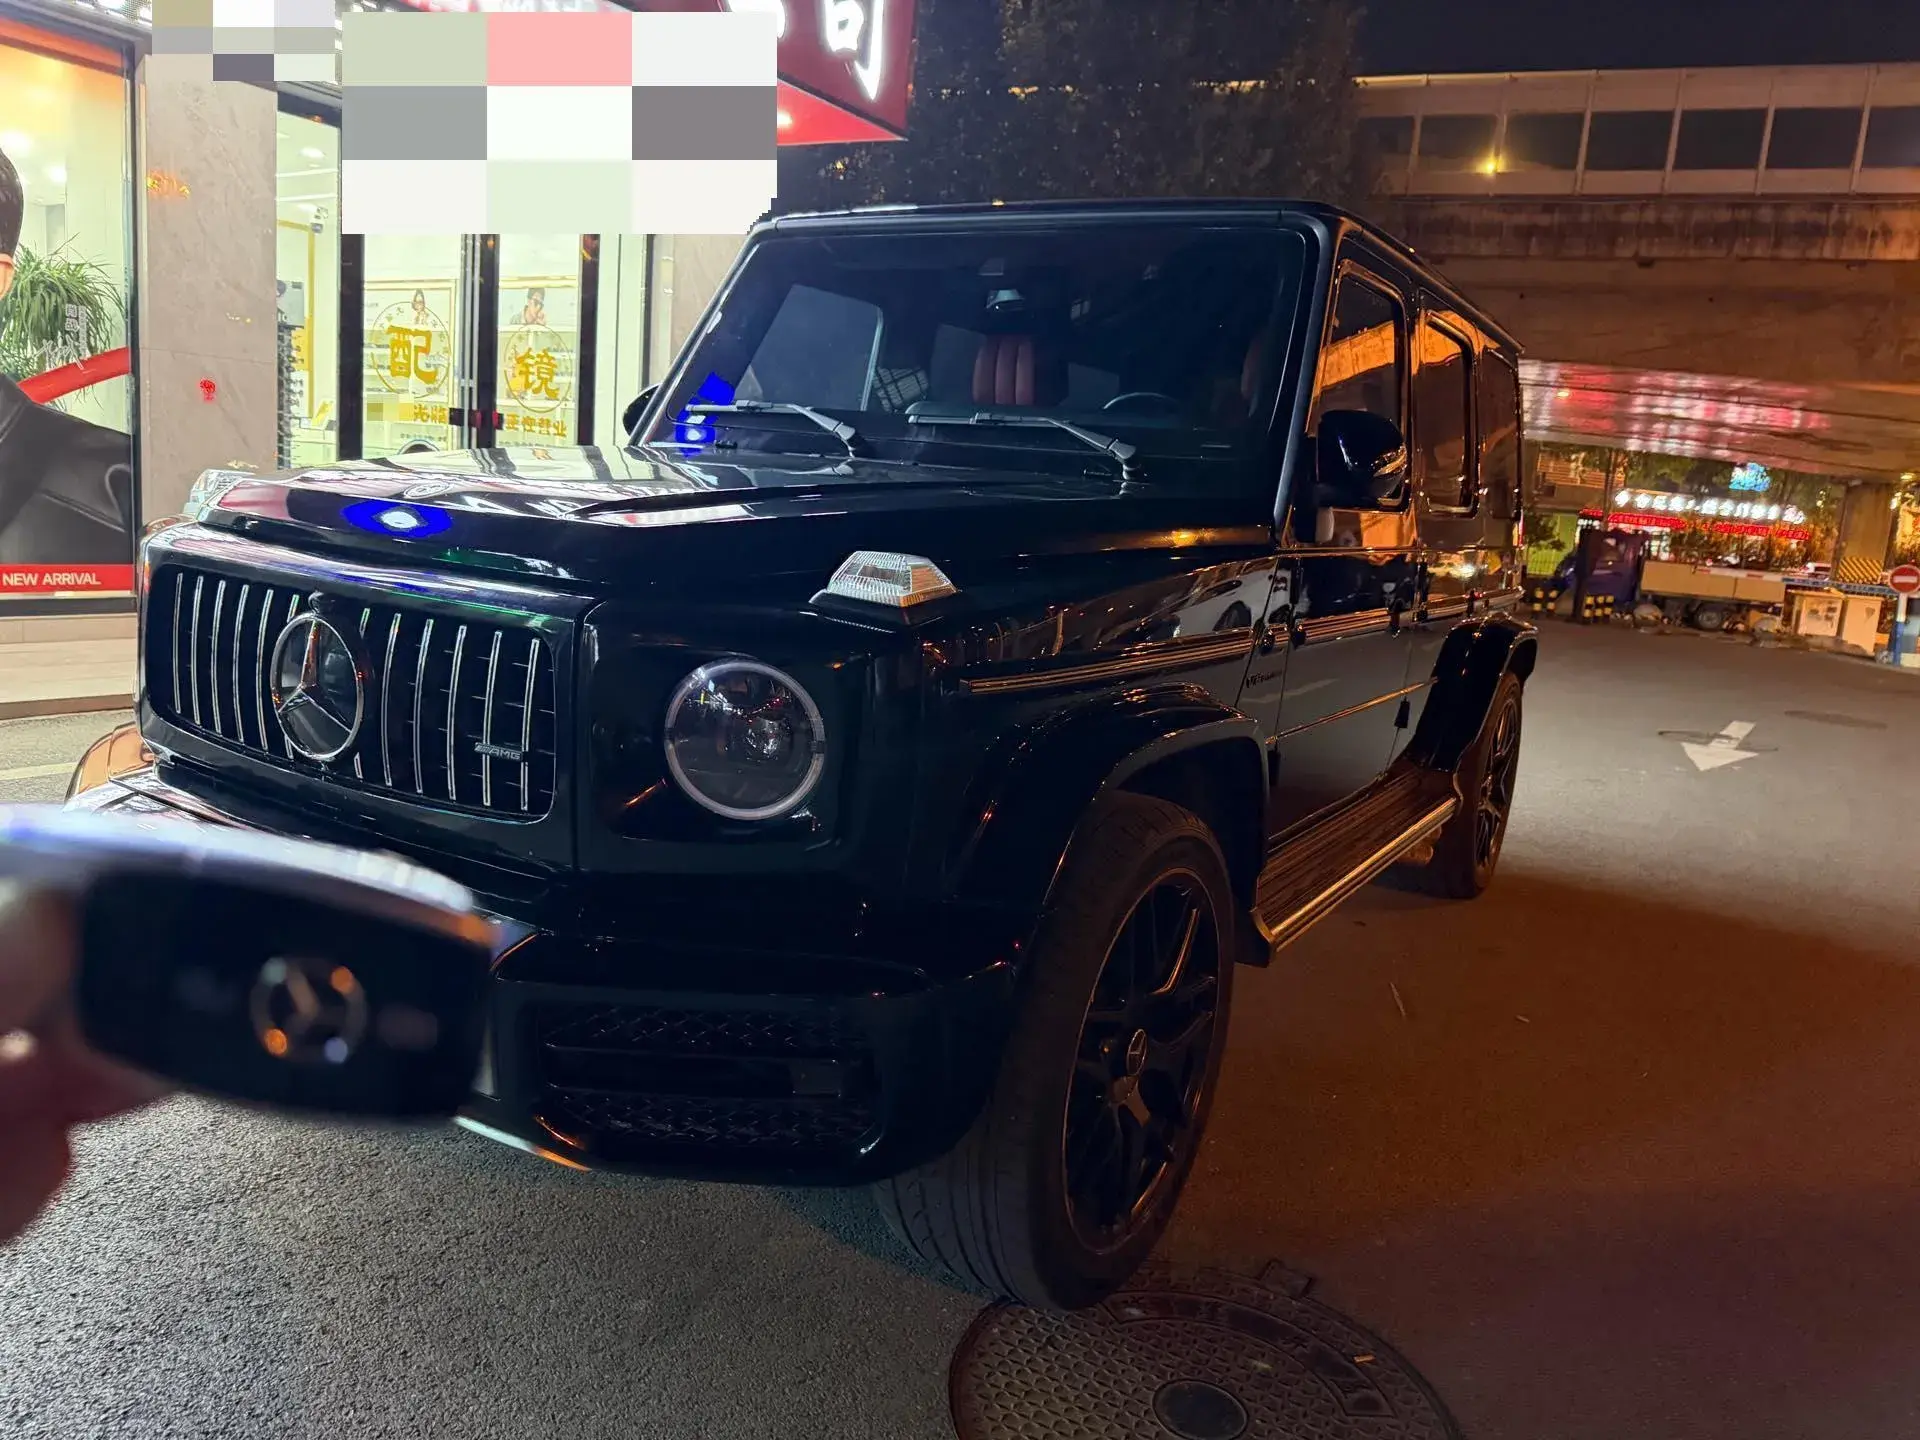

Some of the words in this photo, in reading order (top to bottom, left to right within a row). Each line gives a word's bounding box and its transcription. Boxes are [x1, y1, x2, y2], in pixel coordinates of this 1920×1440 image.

[386, 324, 438, 385] 配
[515, 347, 560, 400] 镜
[2, 572, 38, 586] NEW
[42, 572, 102, 586] ARRIVAL
[488, 747, 521, 760] AMG
